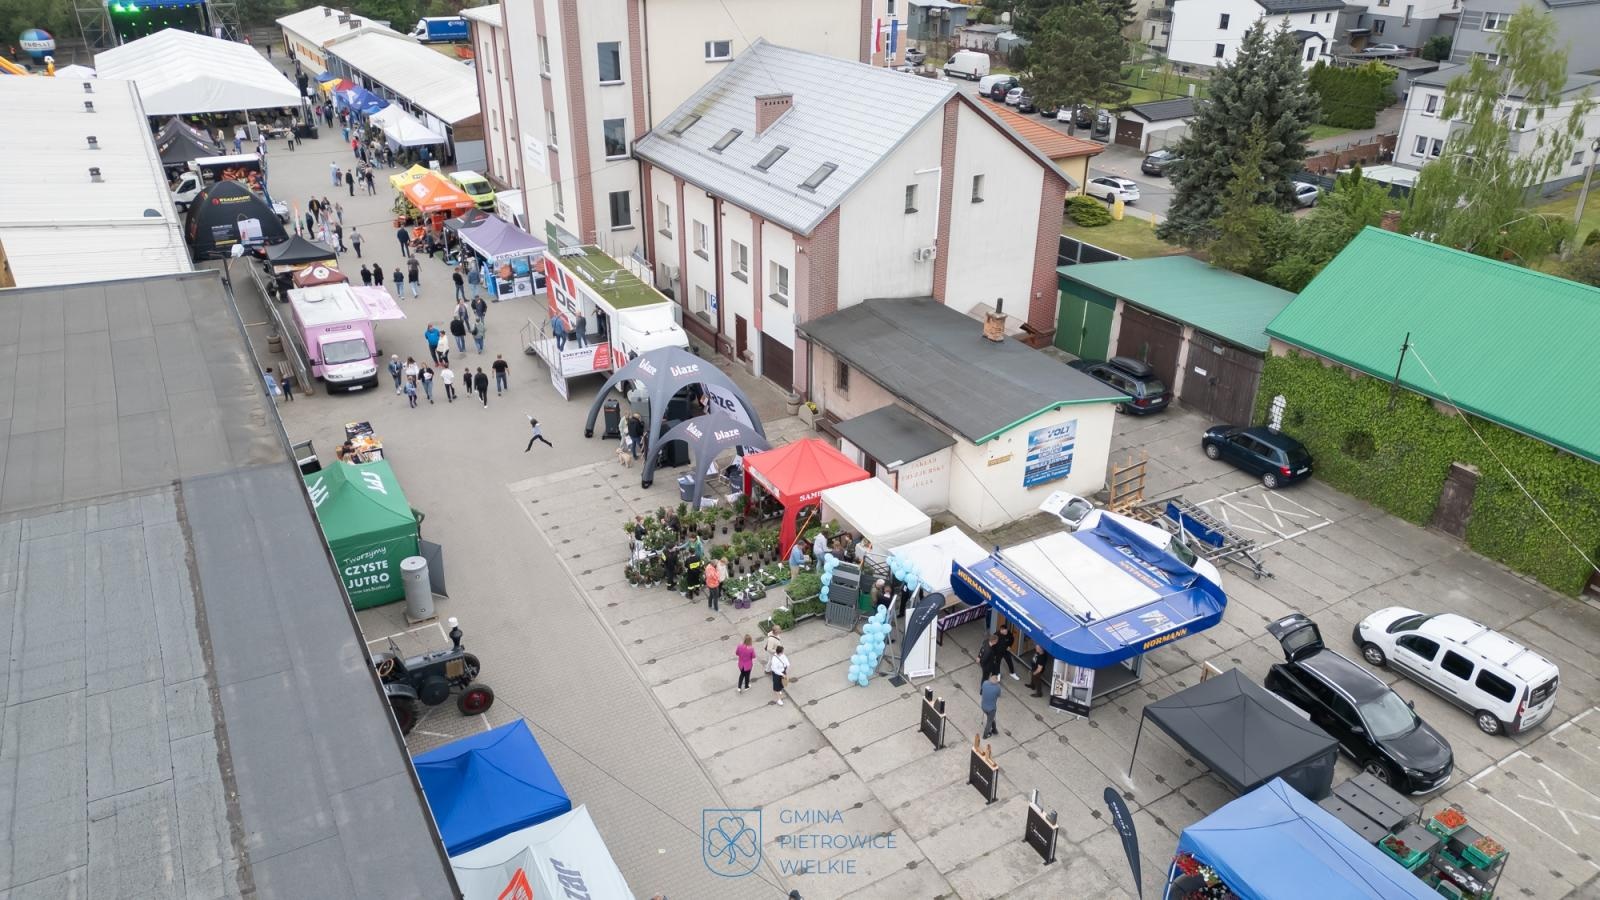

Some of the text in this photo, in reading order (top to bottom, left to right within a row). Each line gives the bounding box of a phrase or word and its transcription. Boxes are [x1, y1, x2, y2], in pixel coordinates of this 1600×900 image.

[638, 358, 657, 376] blaze
[669, 363, 700, 377] blaze
[686, 422, 703, 439] blaze
[714, 427, 740, 441] blaze
[343, 546, 387, 564] Tworzymy
[345, 559, 389, 576] CZYSTE
[347, 572, 390, 589] JUTRO
